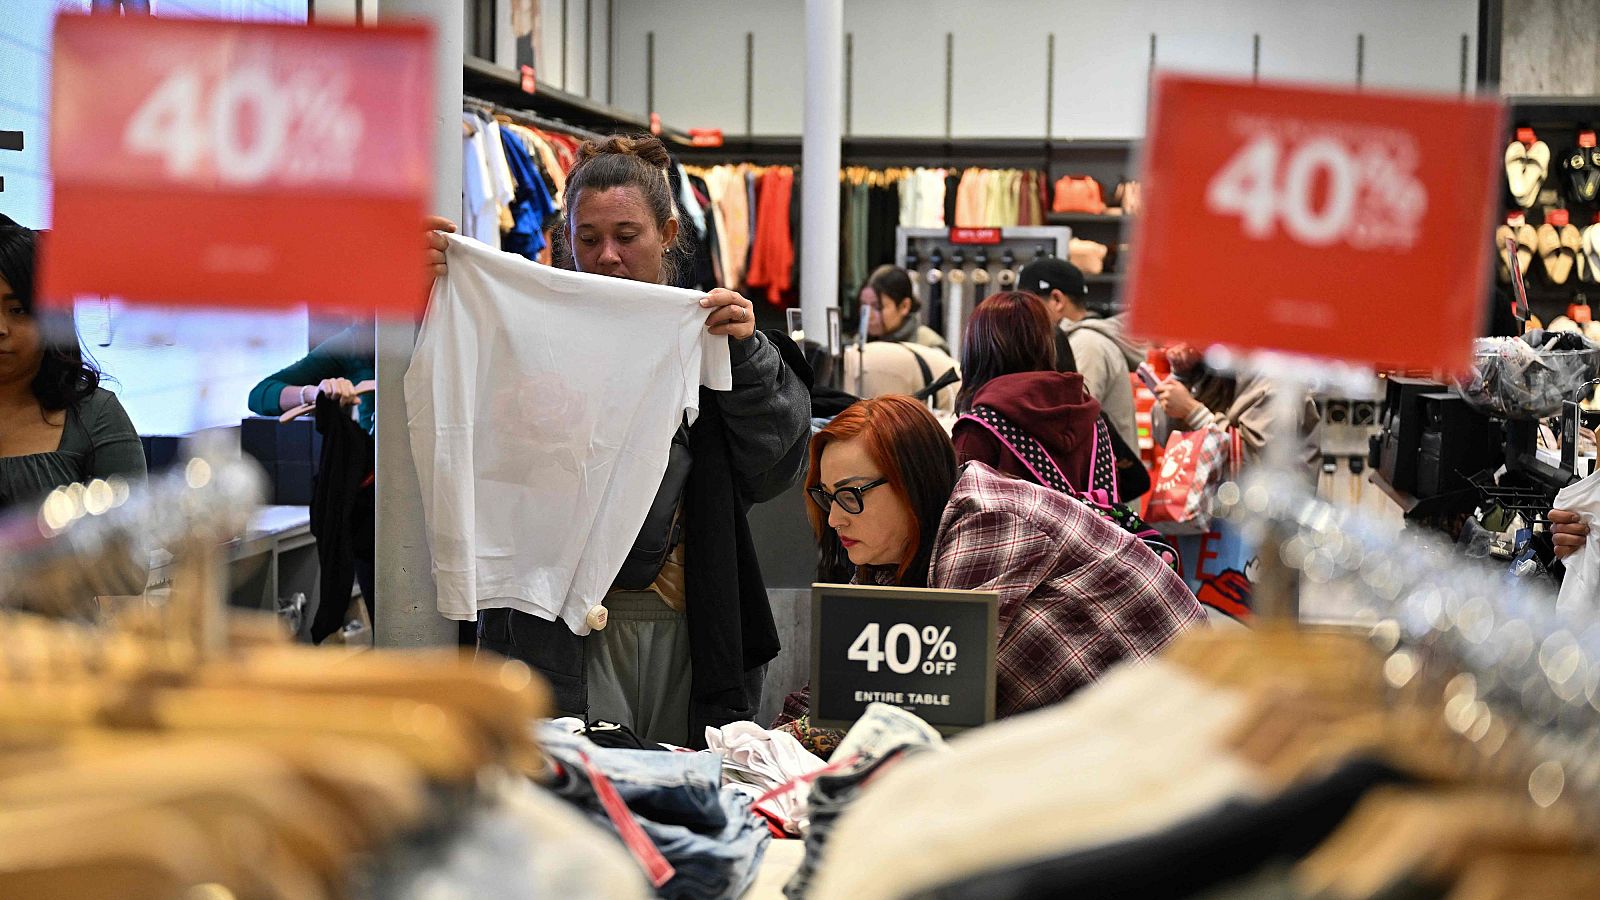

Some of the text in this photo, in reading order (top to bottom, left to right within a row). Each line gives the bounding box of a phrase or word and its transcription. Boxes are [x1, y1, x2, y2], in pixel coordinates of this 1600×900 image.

[124, 67, 362, 184] 40%
[1207, 134, 1427, 246] 40%
[847, 622, 957, 676] 40% OFF
[854, 690, 951, 706] ENTIRE TABLE
